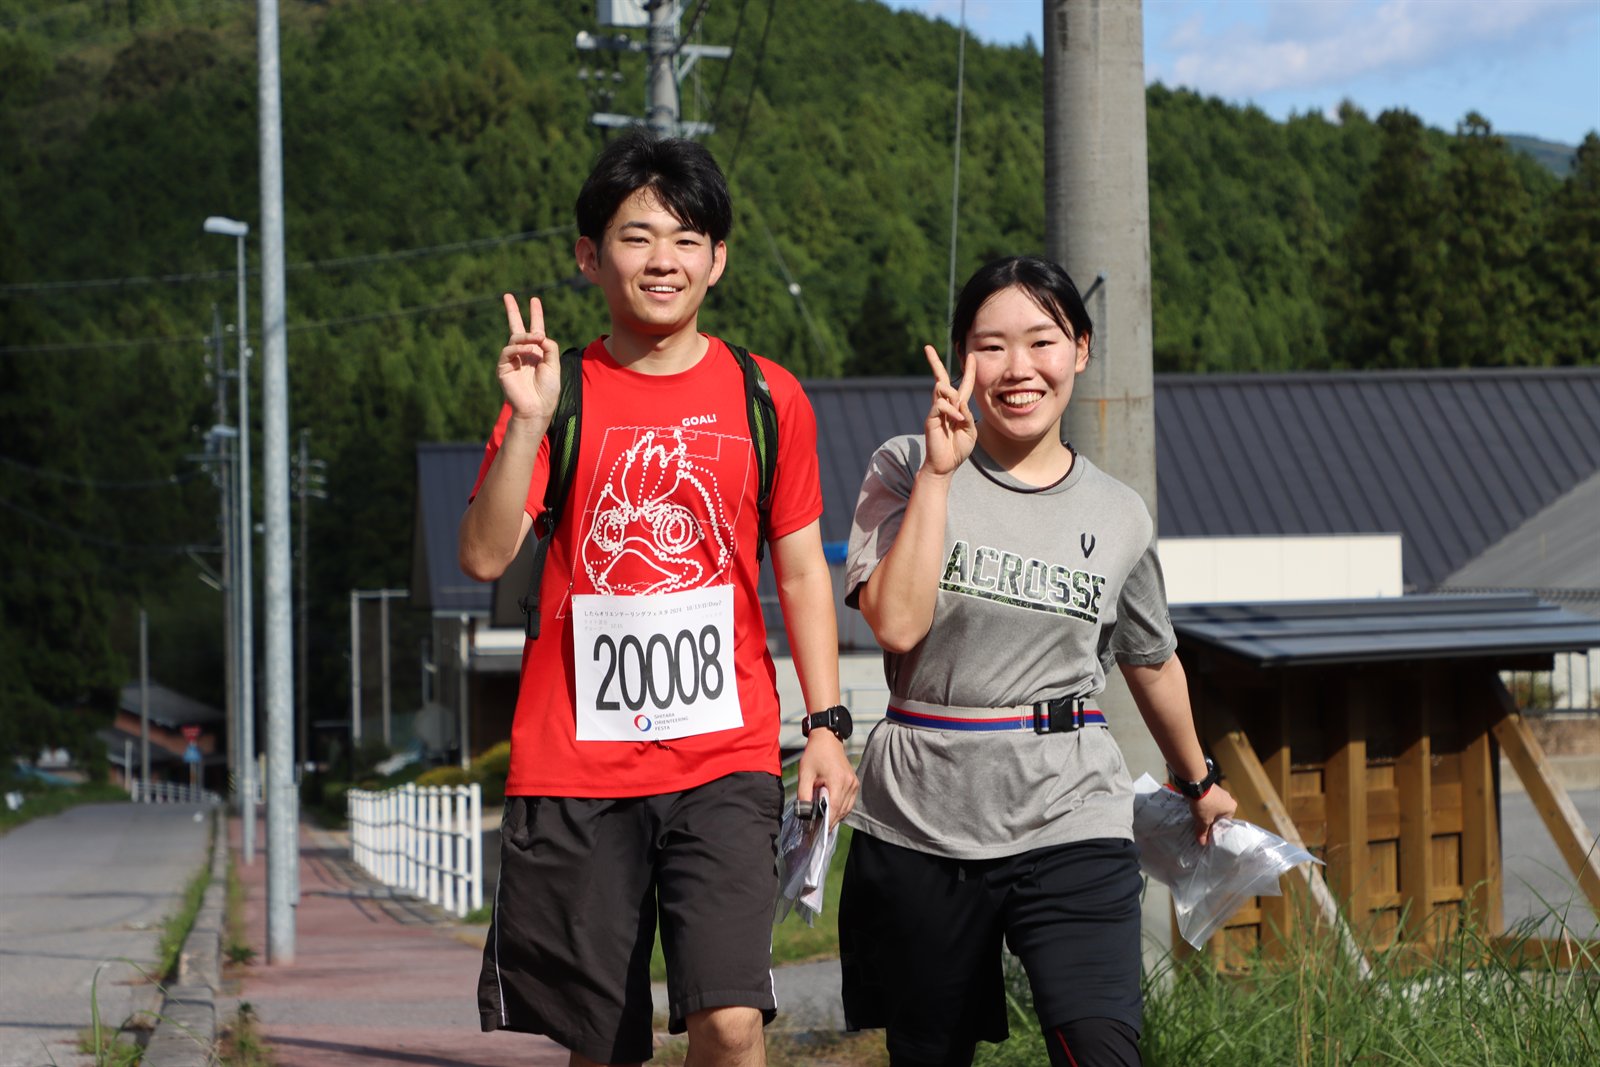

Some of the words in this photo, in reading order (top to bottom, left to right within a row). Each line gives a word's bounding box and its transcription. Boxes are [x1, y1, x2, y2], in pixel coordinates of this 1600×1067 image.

[682, 413, 717, 427] GOAL!
[940, 540, 1107, 616] ACROSSE
[593, 624, 724, 712] 20008
[654, 716, 689, 726] ORIENTEERING
